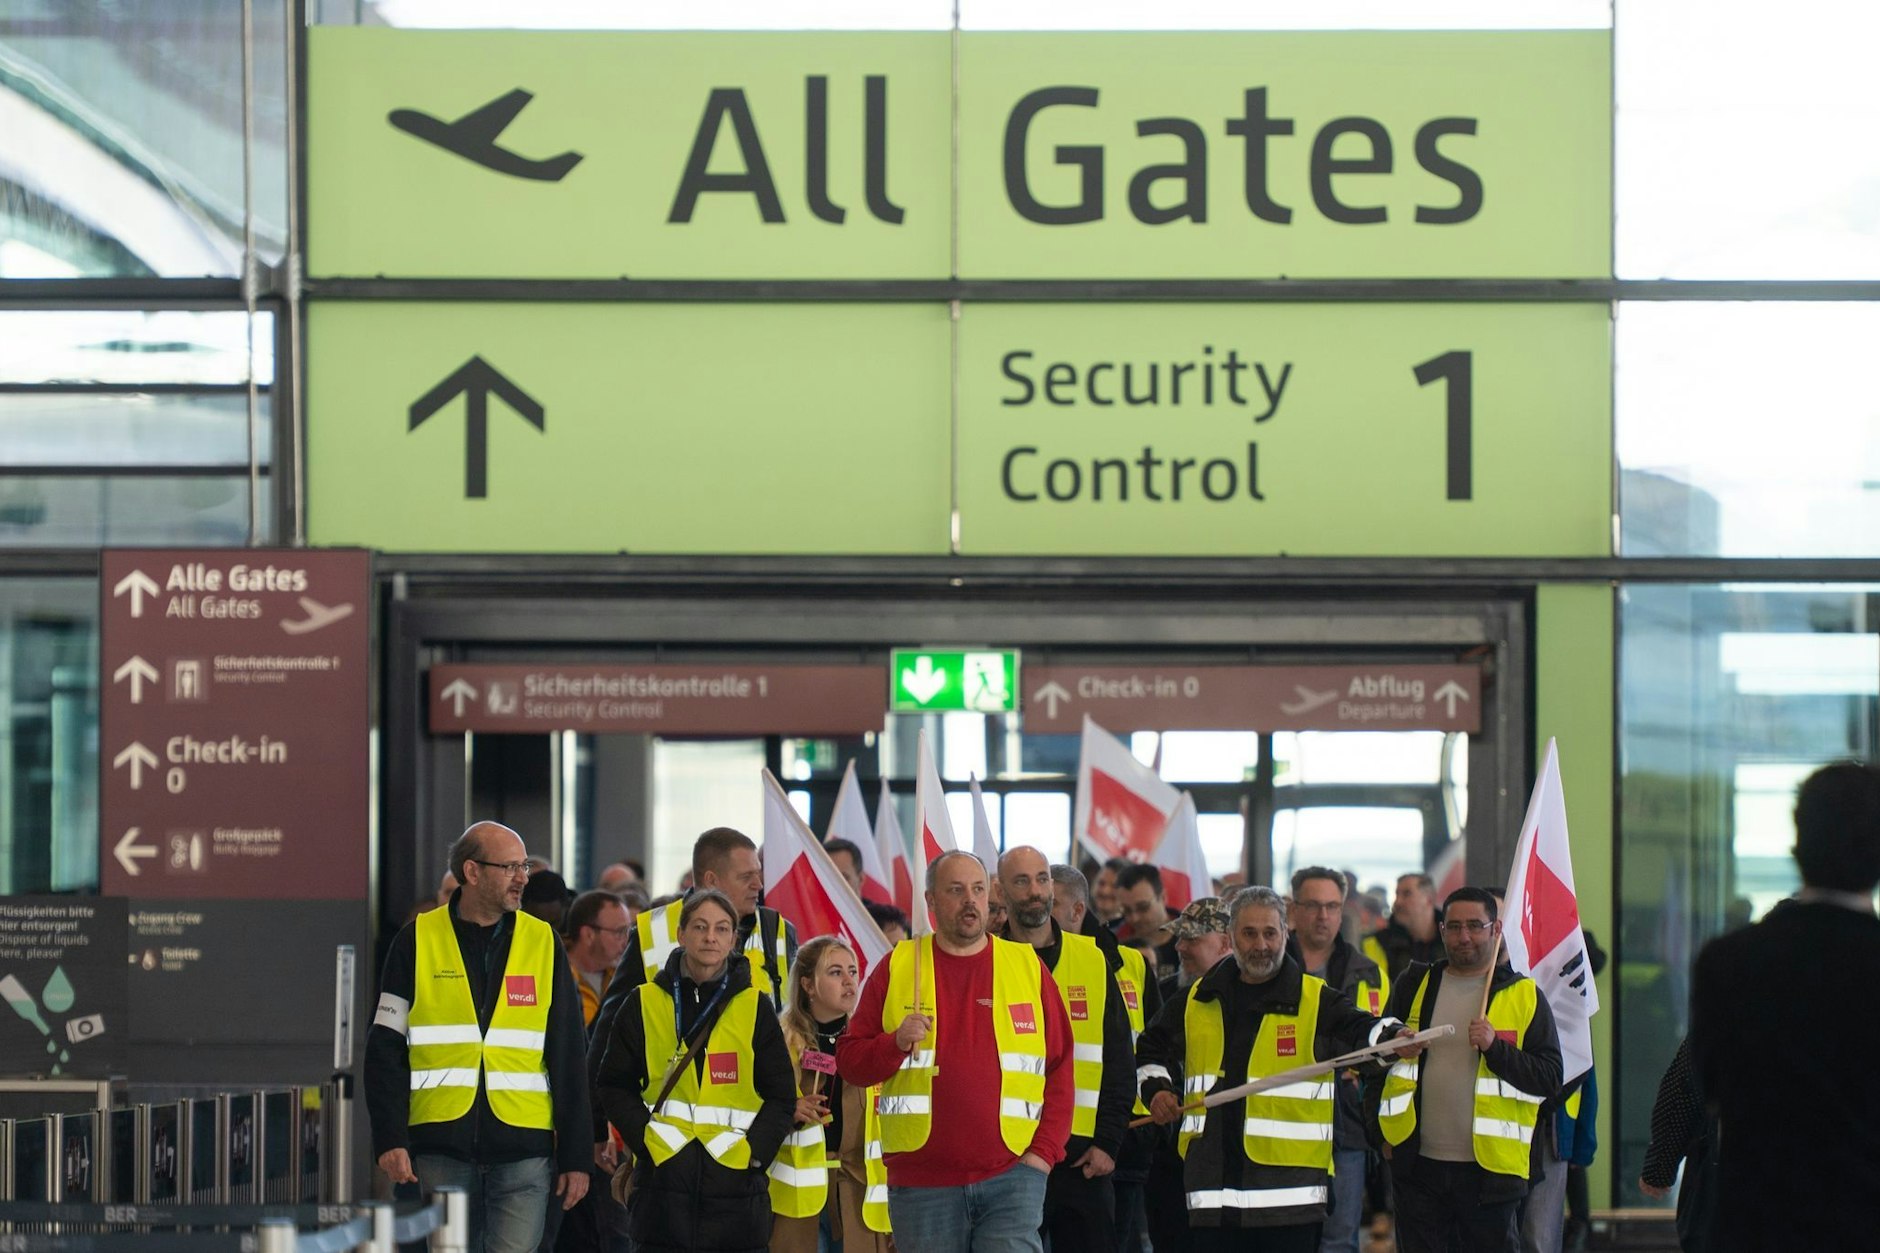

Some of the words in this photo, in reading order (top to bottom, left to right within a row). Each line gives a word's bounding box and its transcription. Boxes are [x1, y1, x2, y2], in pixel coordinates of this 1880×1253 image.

[666, 75, 905, 226] All
[1002, 85, 1485, 227] Gates
[1000, 346, 1293, 424] Security
[1412, 350, 1473, 502] 1
[1000, 442, 1266, 504] Control
[165, 564, 222, 592] Alle
[228, 564, 308, 592] Gates
[165, 595, 195, 619] All
[200, 595, 262, 619] Gates
[523, 674, 752, 698] Sicherheitskontrolle
[756, 675, 769, 698] 1
[1077, 675, 1178, 699] Check-in
[1182, 676, 1200, 699] 0
[1348, 675, 1425, 702] Abflug
[523, 700, 593, 720] Security
[598, 700, 663, 719] Control
[1337, 701, 1425, 721] Departure
[165, 735, 287, 764] Check-in
[165, 767, 187, 794] 0
[68, 906, 94, 918] bitte
[21, 920, 78, 934] entsorgen!
[40, 933, 51, 945] of
[53, 934, 89, 947] liquids
[508, 993, 535, 1003] ver.di
[1014, 1021, 1035, 1030] ver.di
[711, 1070, 737, 1080] ver.di
[104, 1206, 138, 1223] BER
[317, 1206, 351, 1223] BER
[0, 1235, 27, 1252] ER
